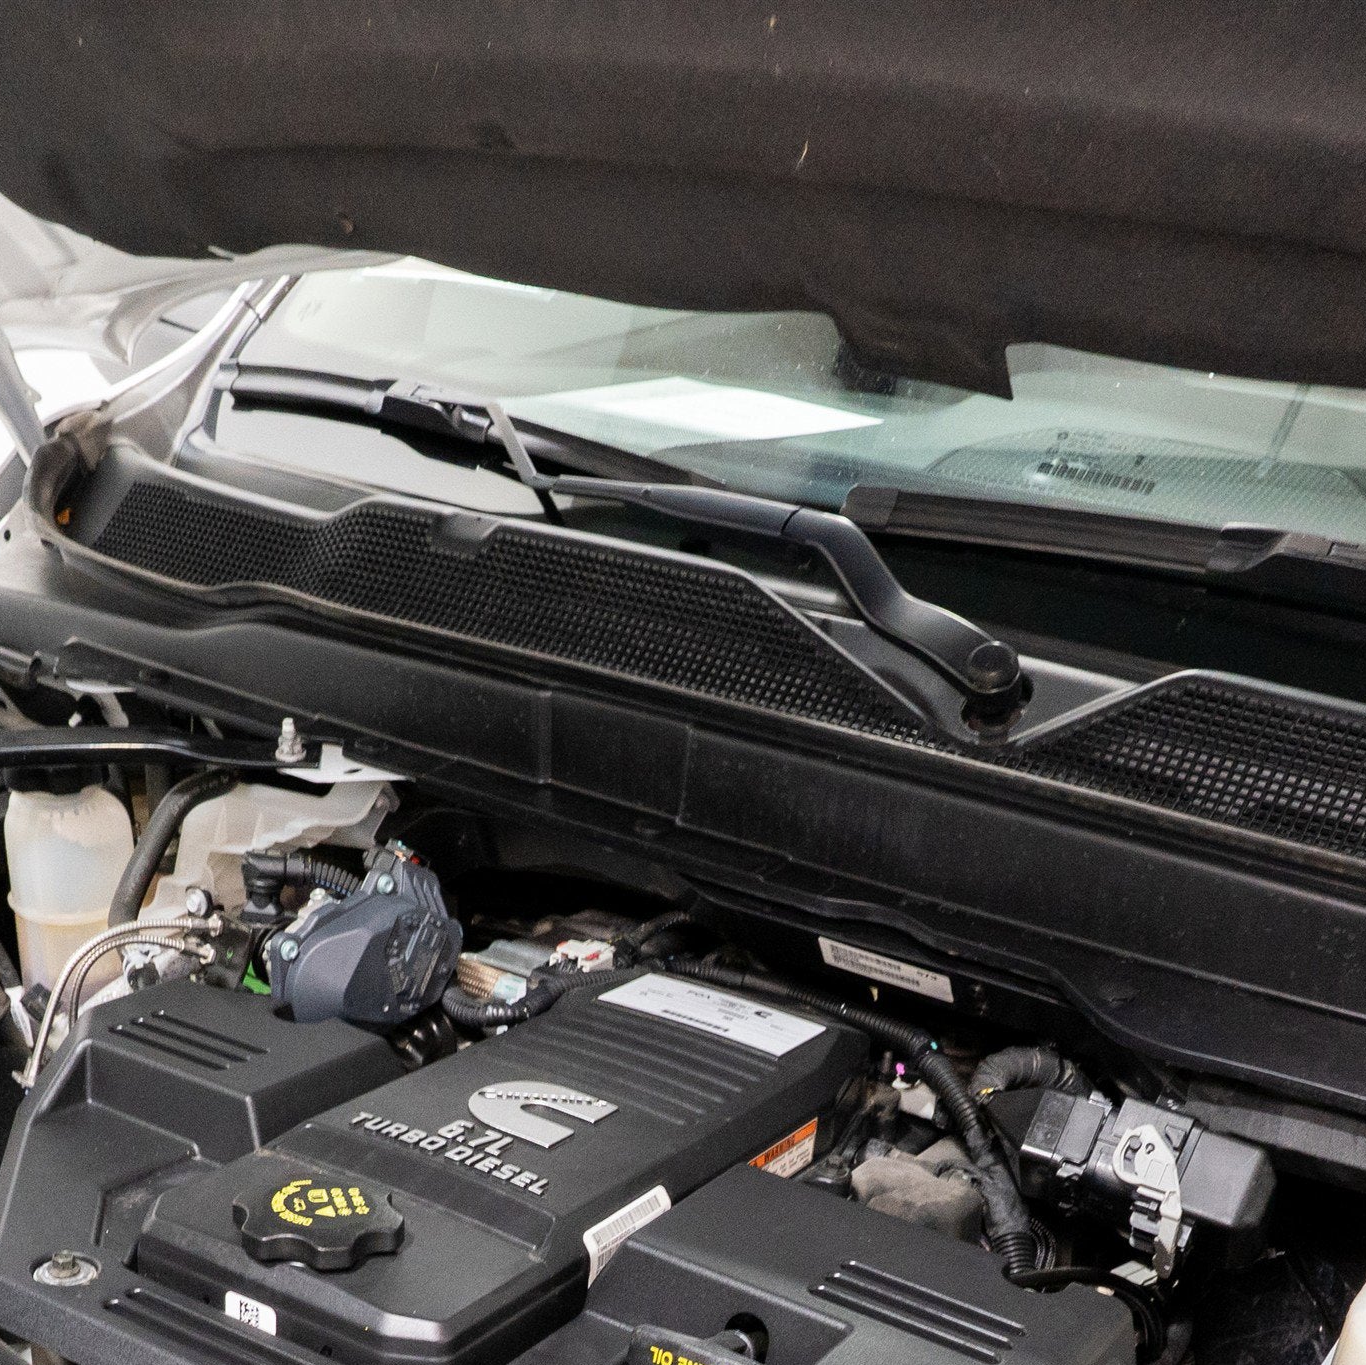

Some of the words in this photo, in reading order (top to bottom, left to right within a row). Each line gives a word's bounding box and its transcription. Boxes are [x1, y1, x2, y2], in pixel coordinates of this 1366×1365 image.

[350, 1112, 446, 1151] TURBO
[444, 1145, 549, 1195] DIESEL
[438, 1120, 514, 1157] 6.7L
